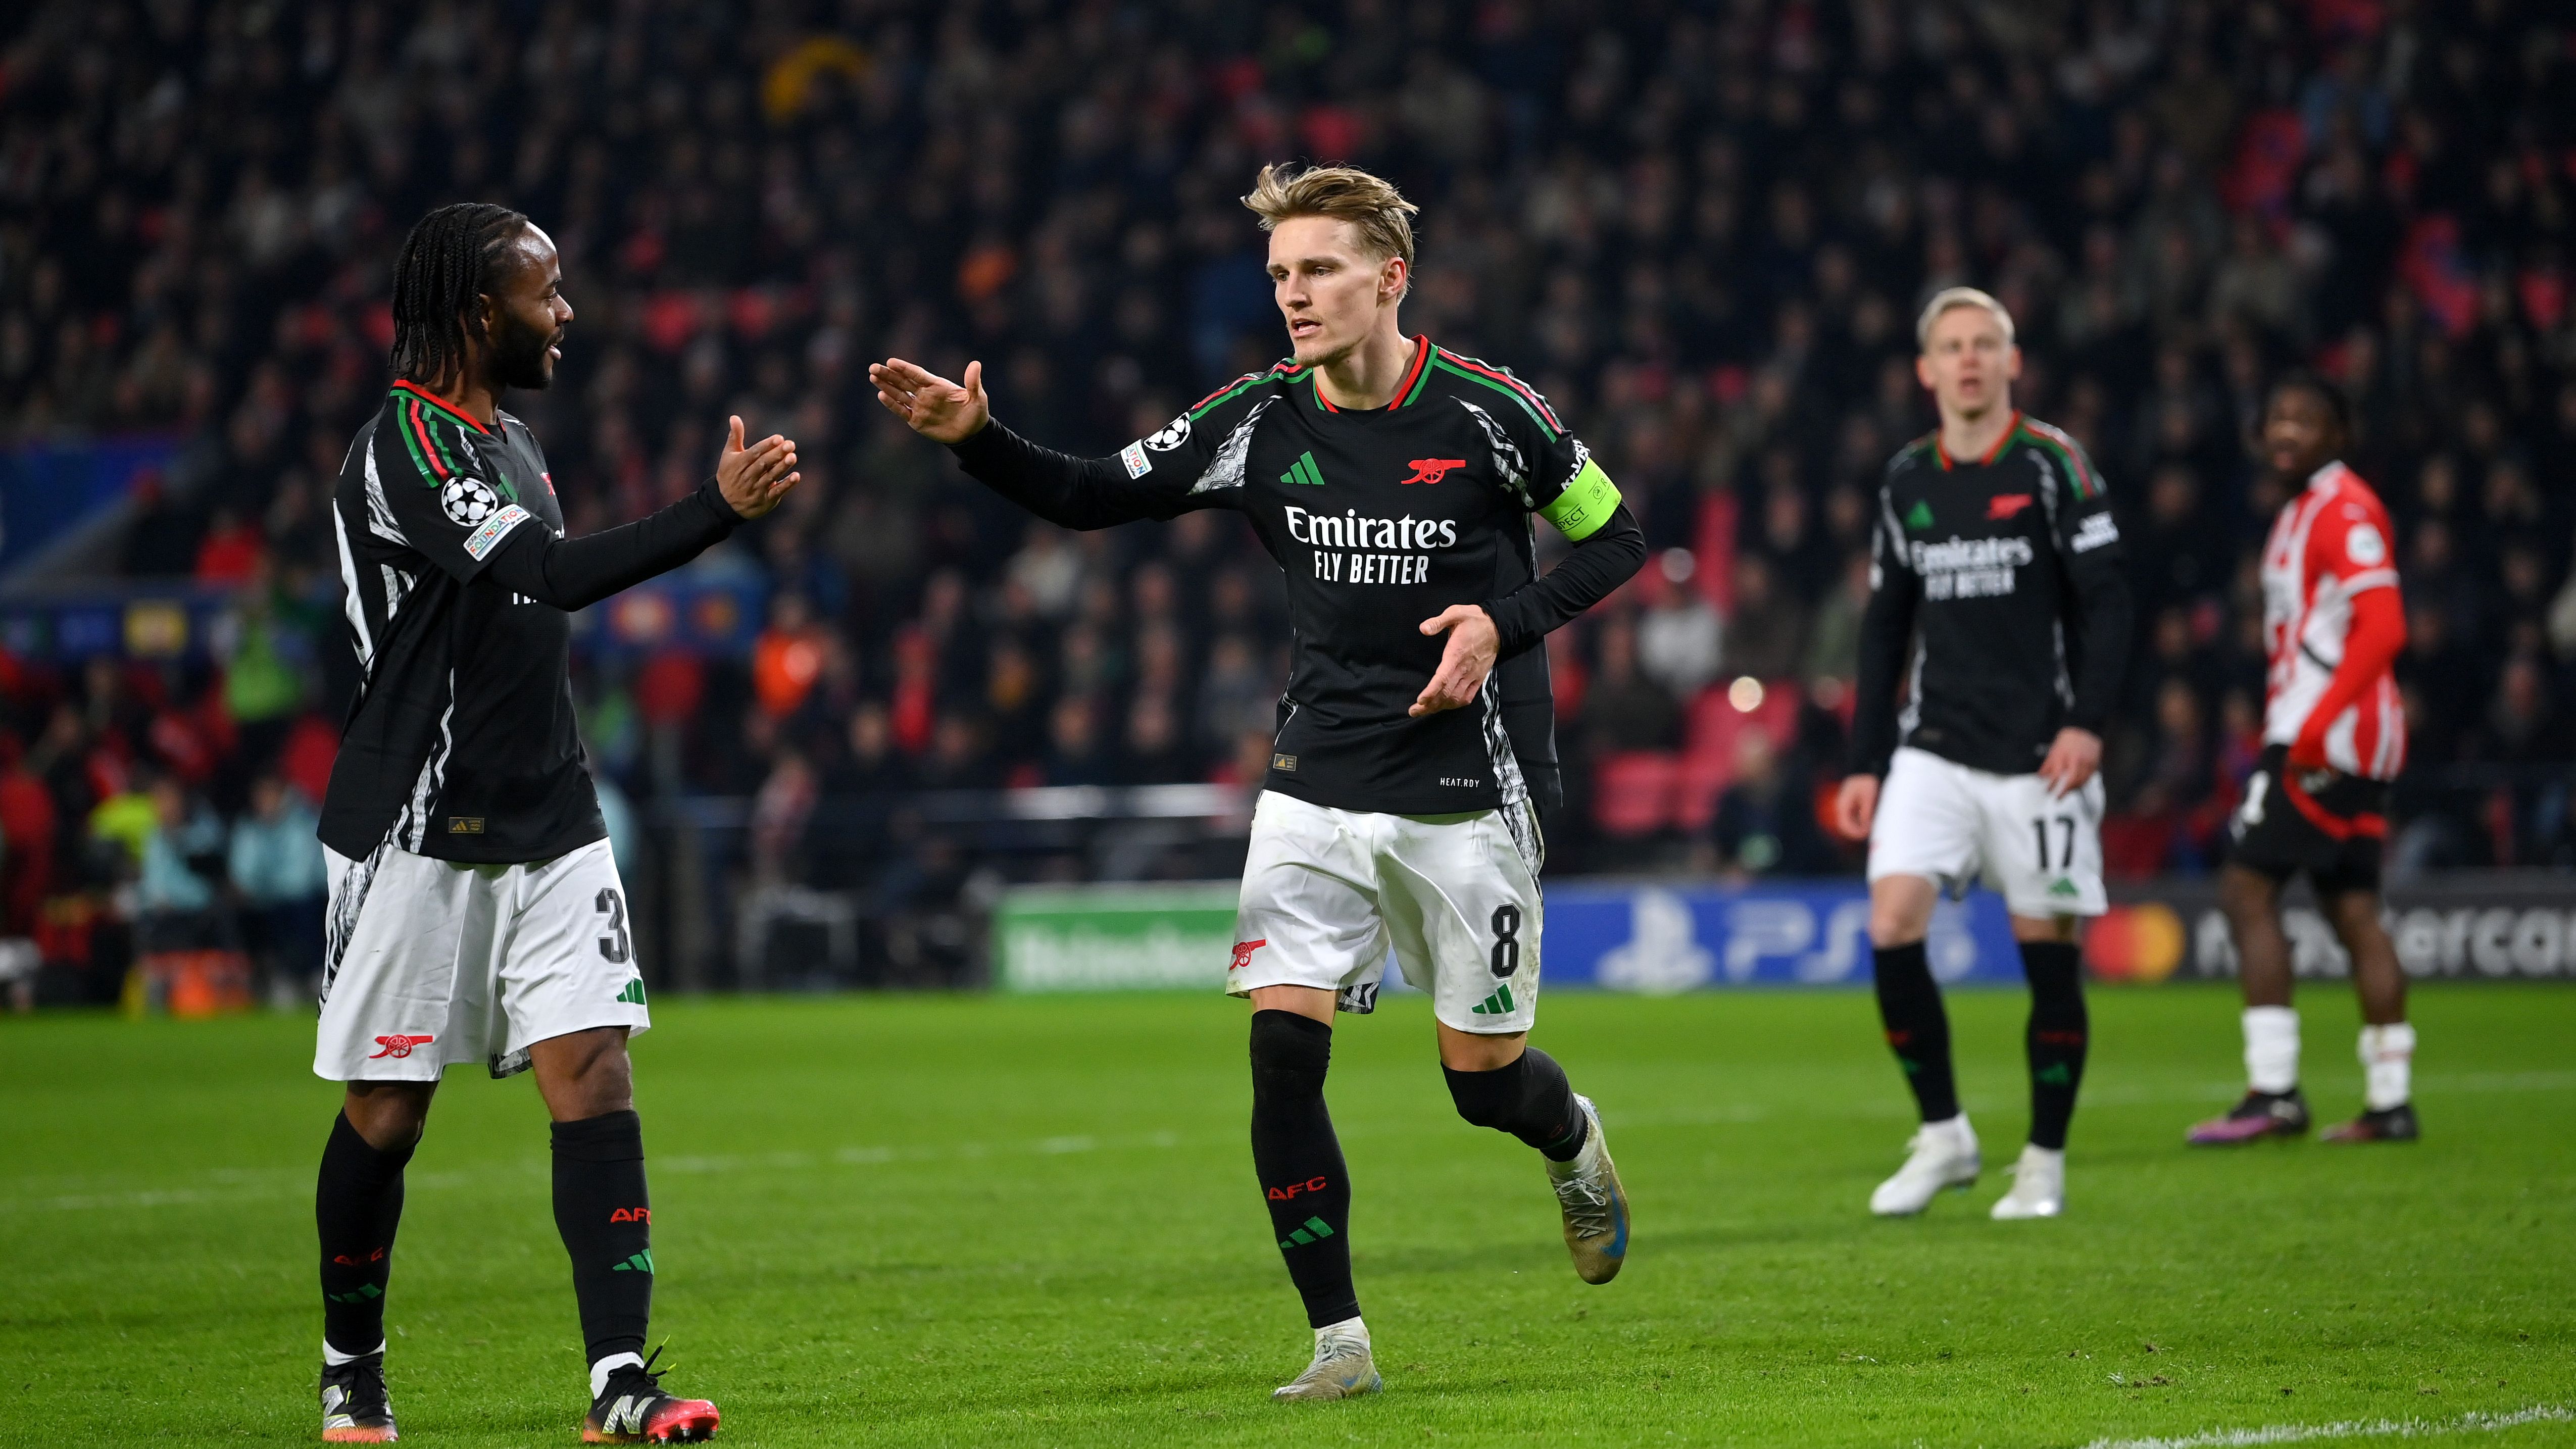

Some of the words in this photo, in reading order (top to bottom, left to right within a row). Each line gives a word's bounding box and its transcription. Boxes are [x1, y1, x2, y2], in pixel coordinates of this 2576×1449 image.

[1127, 444, 1145, 474] DATION
[469, 506, 524, 555] FOUNDATION
[1284, 506, 1456, 549] Emirates
[1553, 507, 1585, 530] SPECT
[1315, 551, 1342, 581] FLY
[1350, 554, 1429, 584] BETTER
[2032, 815, 2075, 871] 17
[1491, 903, 1521, 979] 8
[1268, 1176, 1326, 1200] AFC
